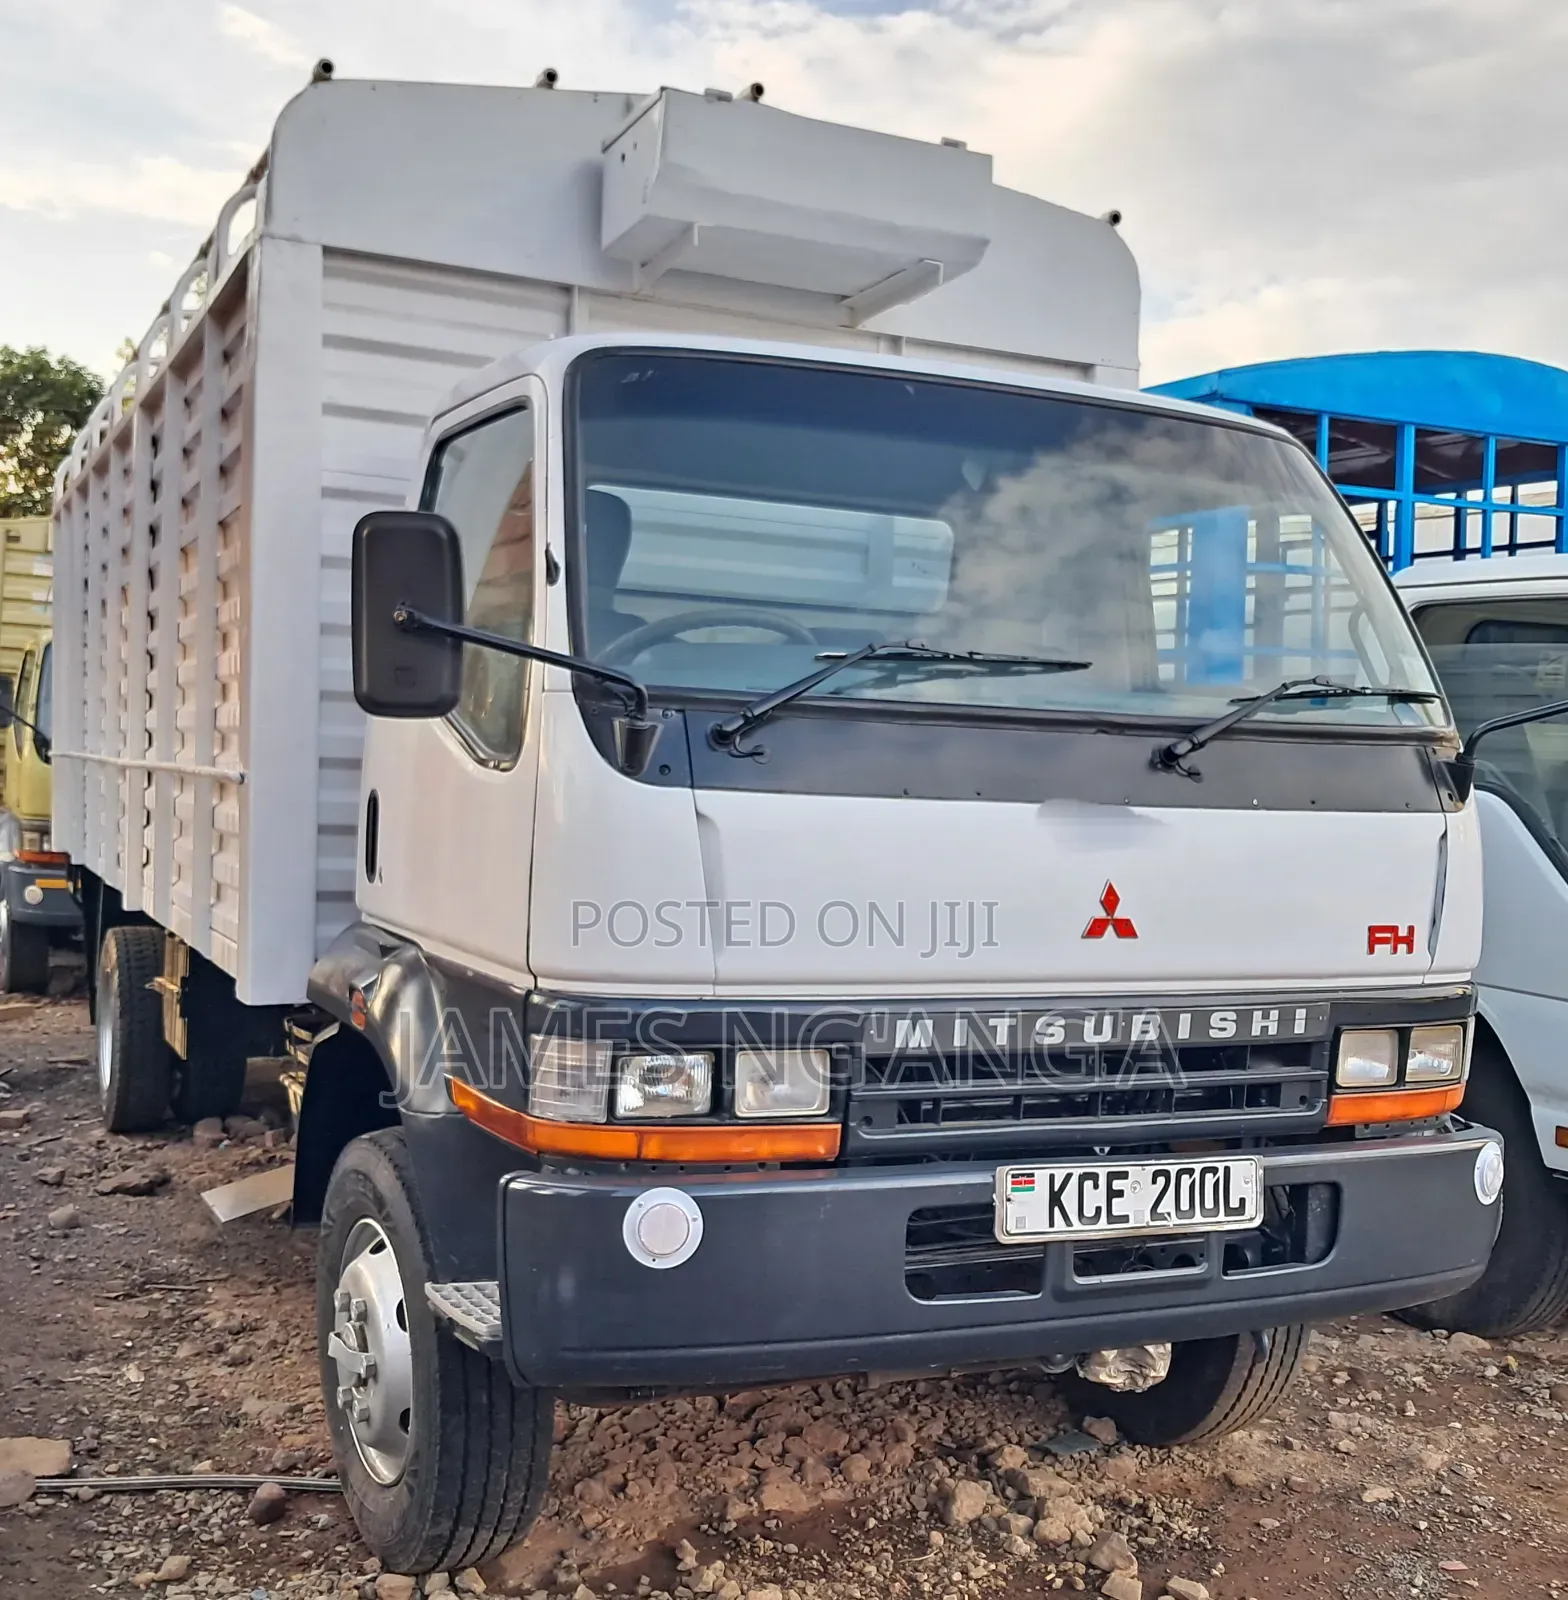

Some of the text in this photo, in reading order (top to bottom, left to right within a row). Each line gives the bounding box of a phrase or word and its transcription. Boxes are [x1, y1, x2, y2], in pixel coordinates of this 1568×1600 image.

[1367, 924, 1415, 955] FH
[894, 1007, 1307, 1049] MITSUBISHI
[1048, 1170, 1130, 1228] KCE
[1149, 1164, 1247, 1222] 200L
